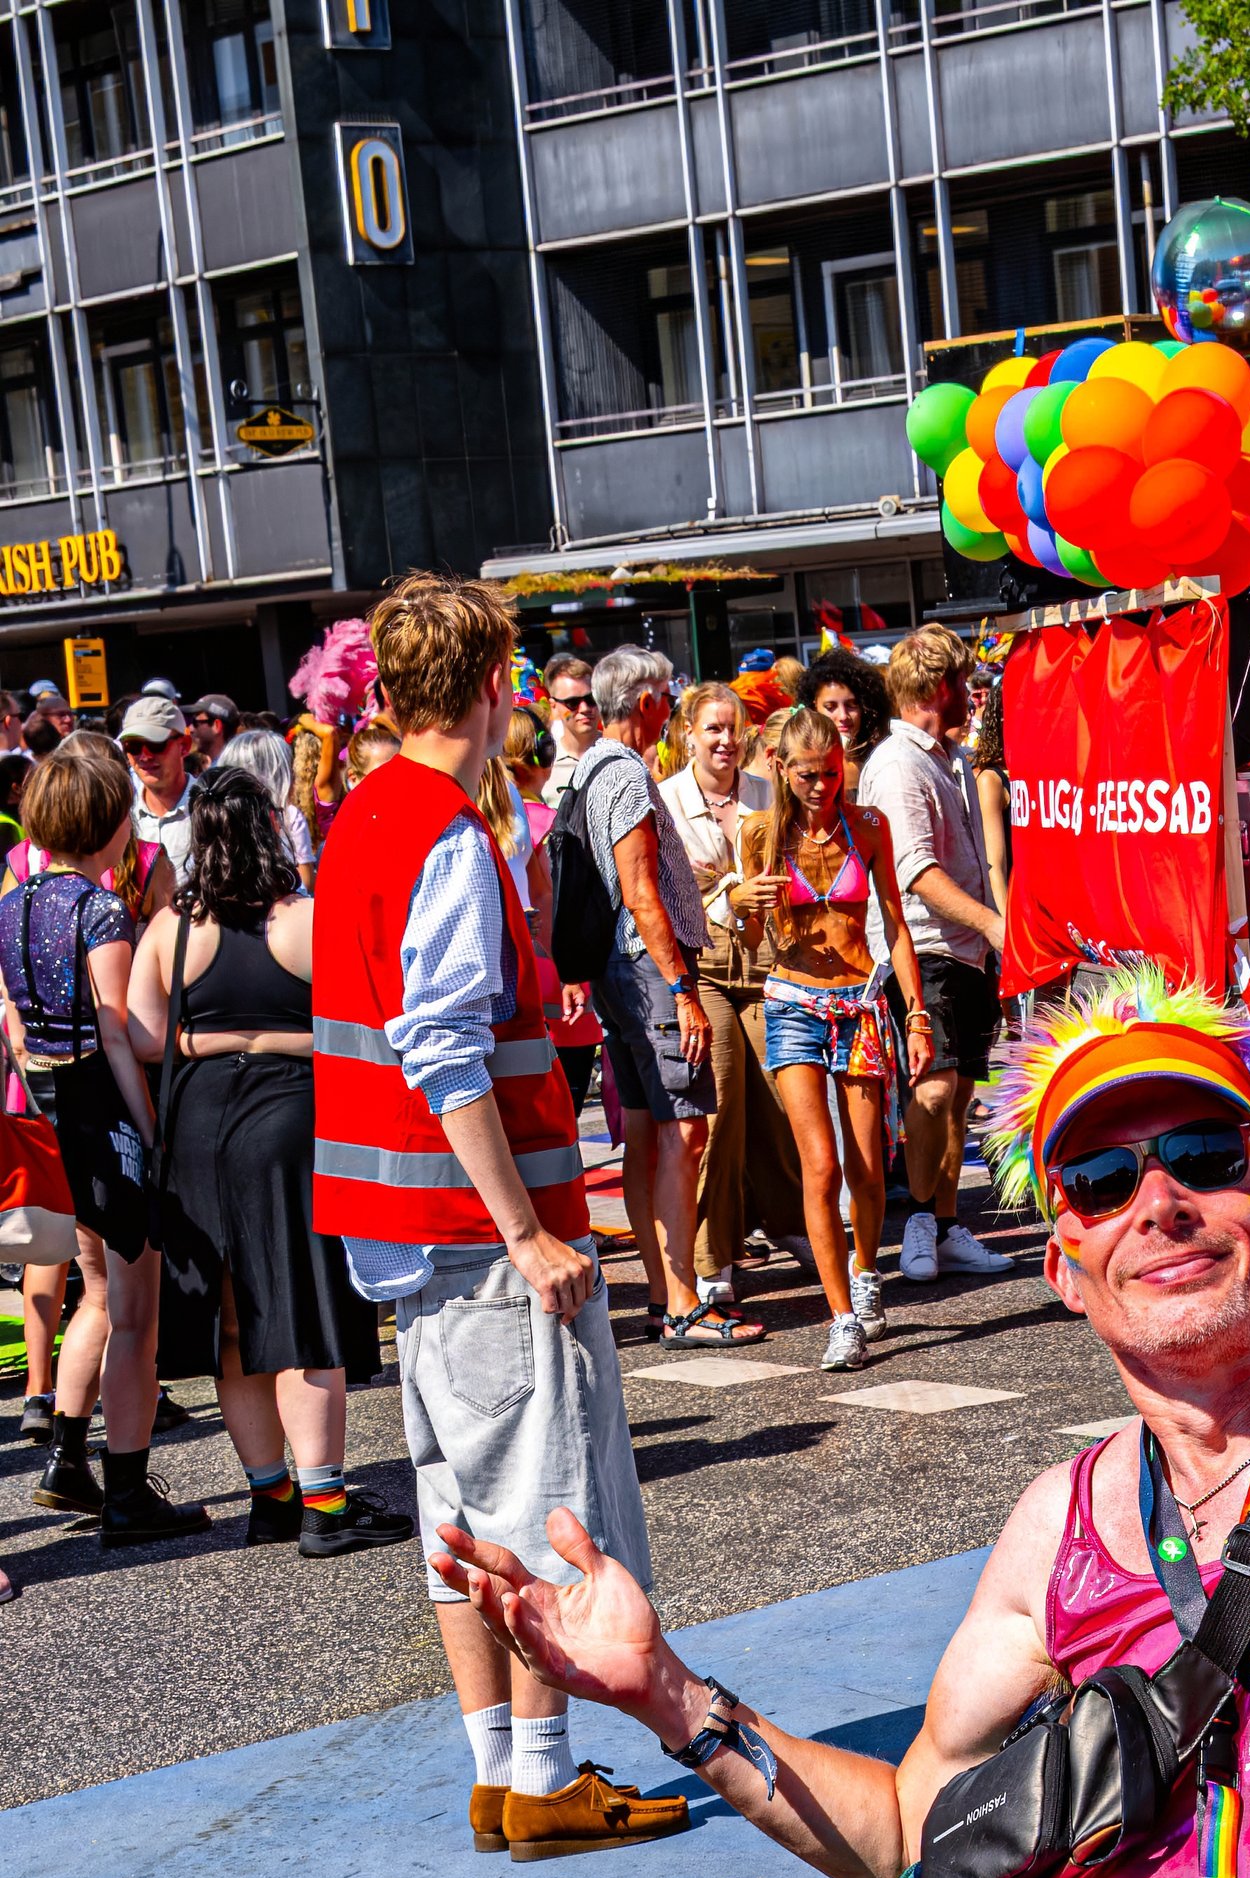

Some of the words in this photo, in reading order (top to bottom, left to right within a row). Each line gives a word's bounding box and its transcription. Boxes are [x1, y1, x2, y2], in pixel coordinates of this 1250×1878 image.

[0, 540, 55, 595] ISH
[58, 528, 121, 588] PUB
[966, 1792, 1007, 1826] FASHION
